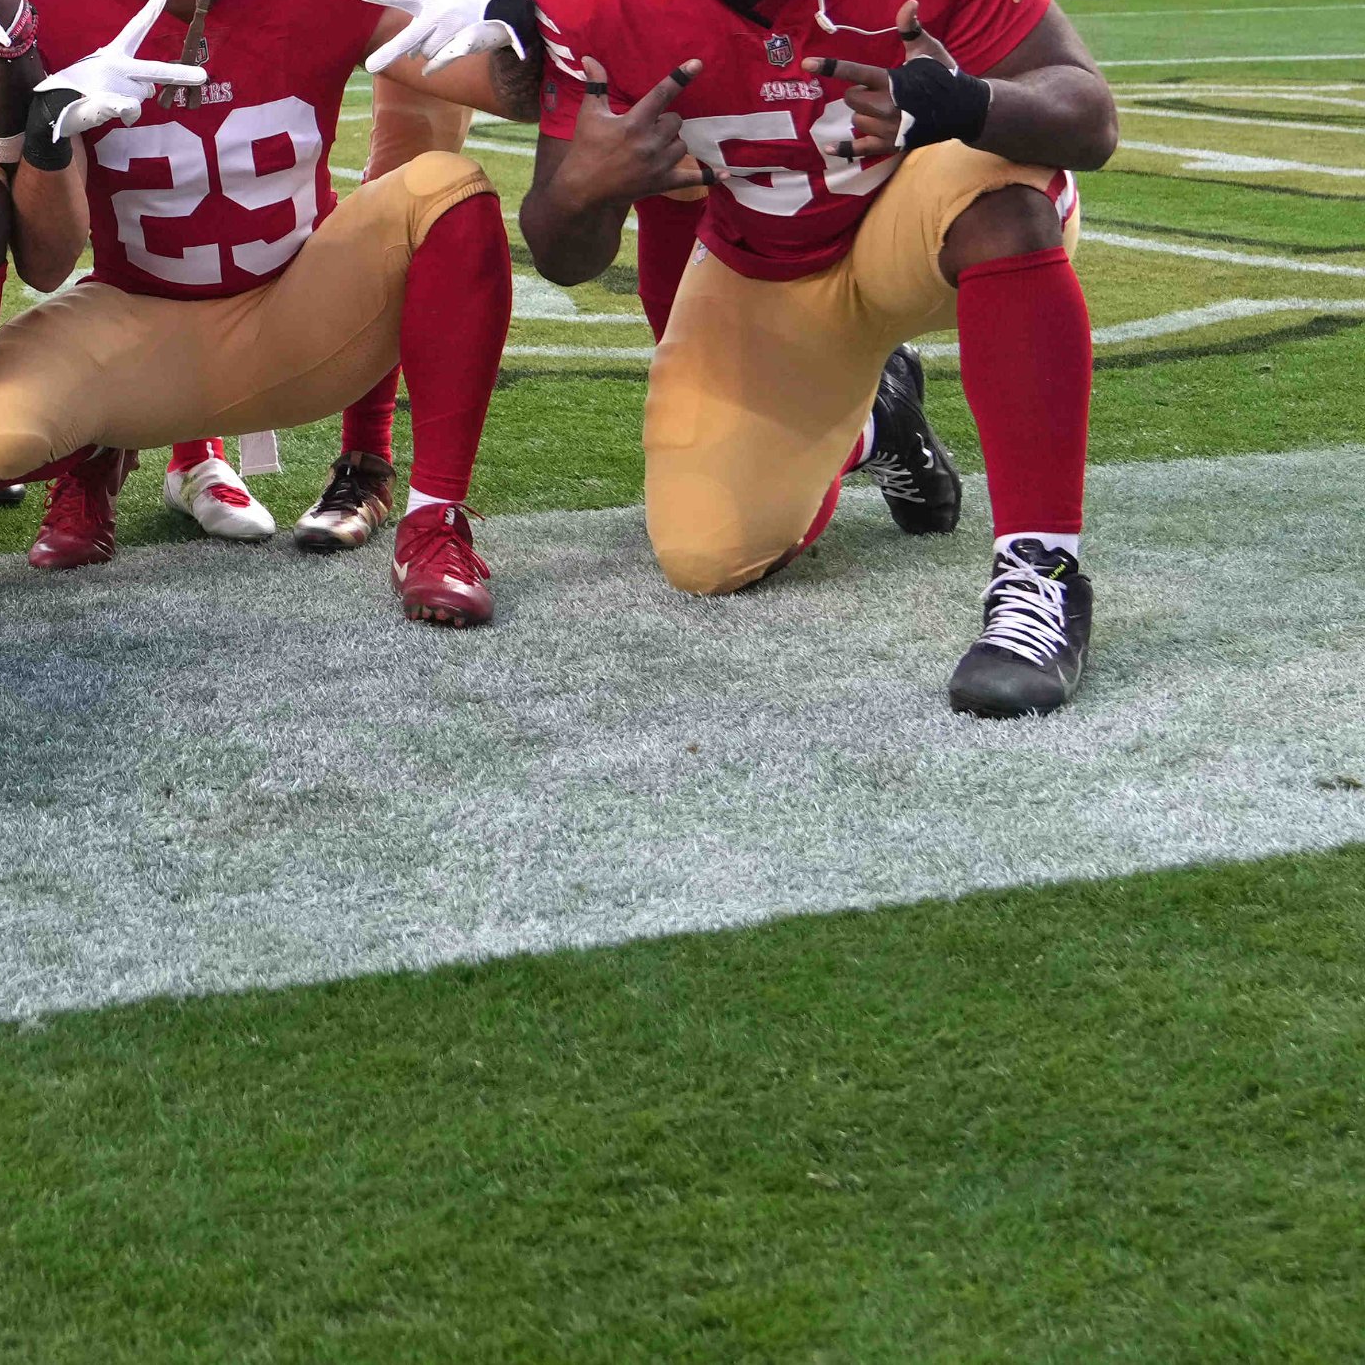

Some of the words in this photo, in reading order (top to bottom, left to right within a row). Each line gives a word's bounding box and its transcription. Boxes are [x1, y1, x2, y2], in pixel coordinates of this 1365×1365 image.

[173, 81, 234, 108] 4ERS
[759, 78, 824, 102] 49ERS
[93, 95, 324, 286] 29
